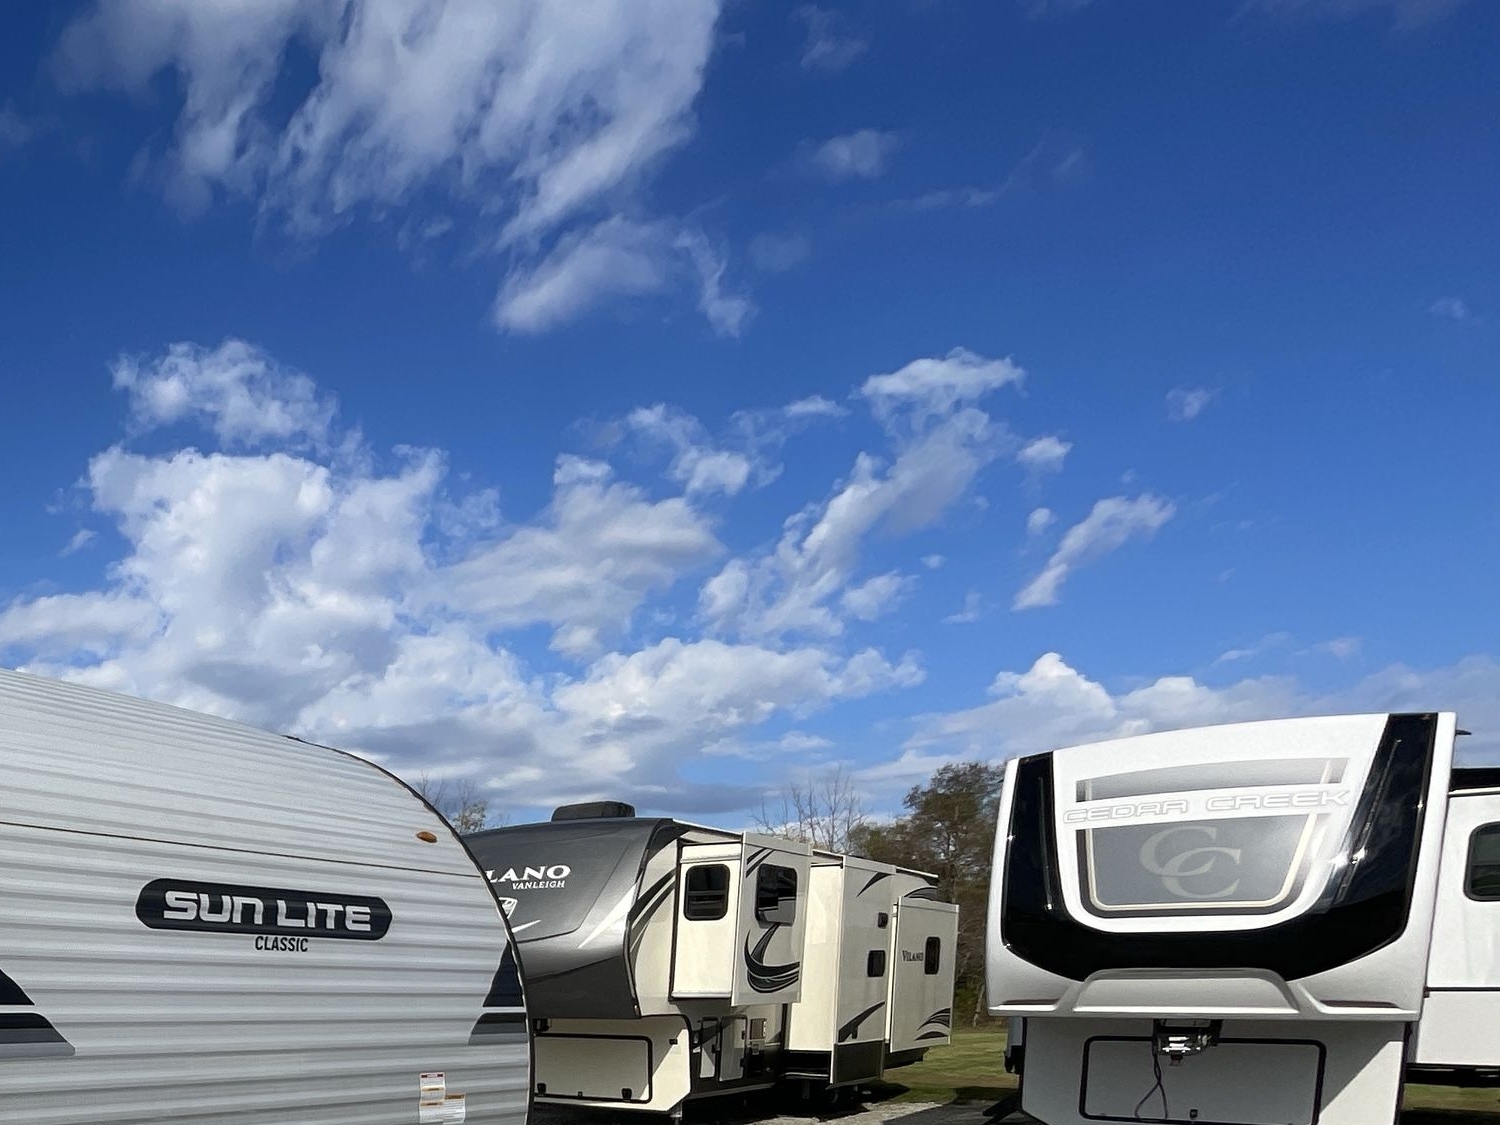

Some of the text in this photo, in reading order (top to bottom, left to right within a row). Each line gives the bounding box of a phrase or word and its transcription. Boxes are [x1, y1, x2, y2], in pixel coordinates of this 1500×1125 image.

[1062, 789, 1351, 825] CEDAR CREEK
[485, 864, 571, 883] LANO
[512, 880, 565, 890] VANLEIGH
[163, 890, 372, 932] SUN LITE
[255, 935, 309, 952] CLASSIC
